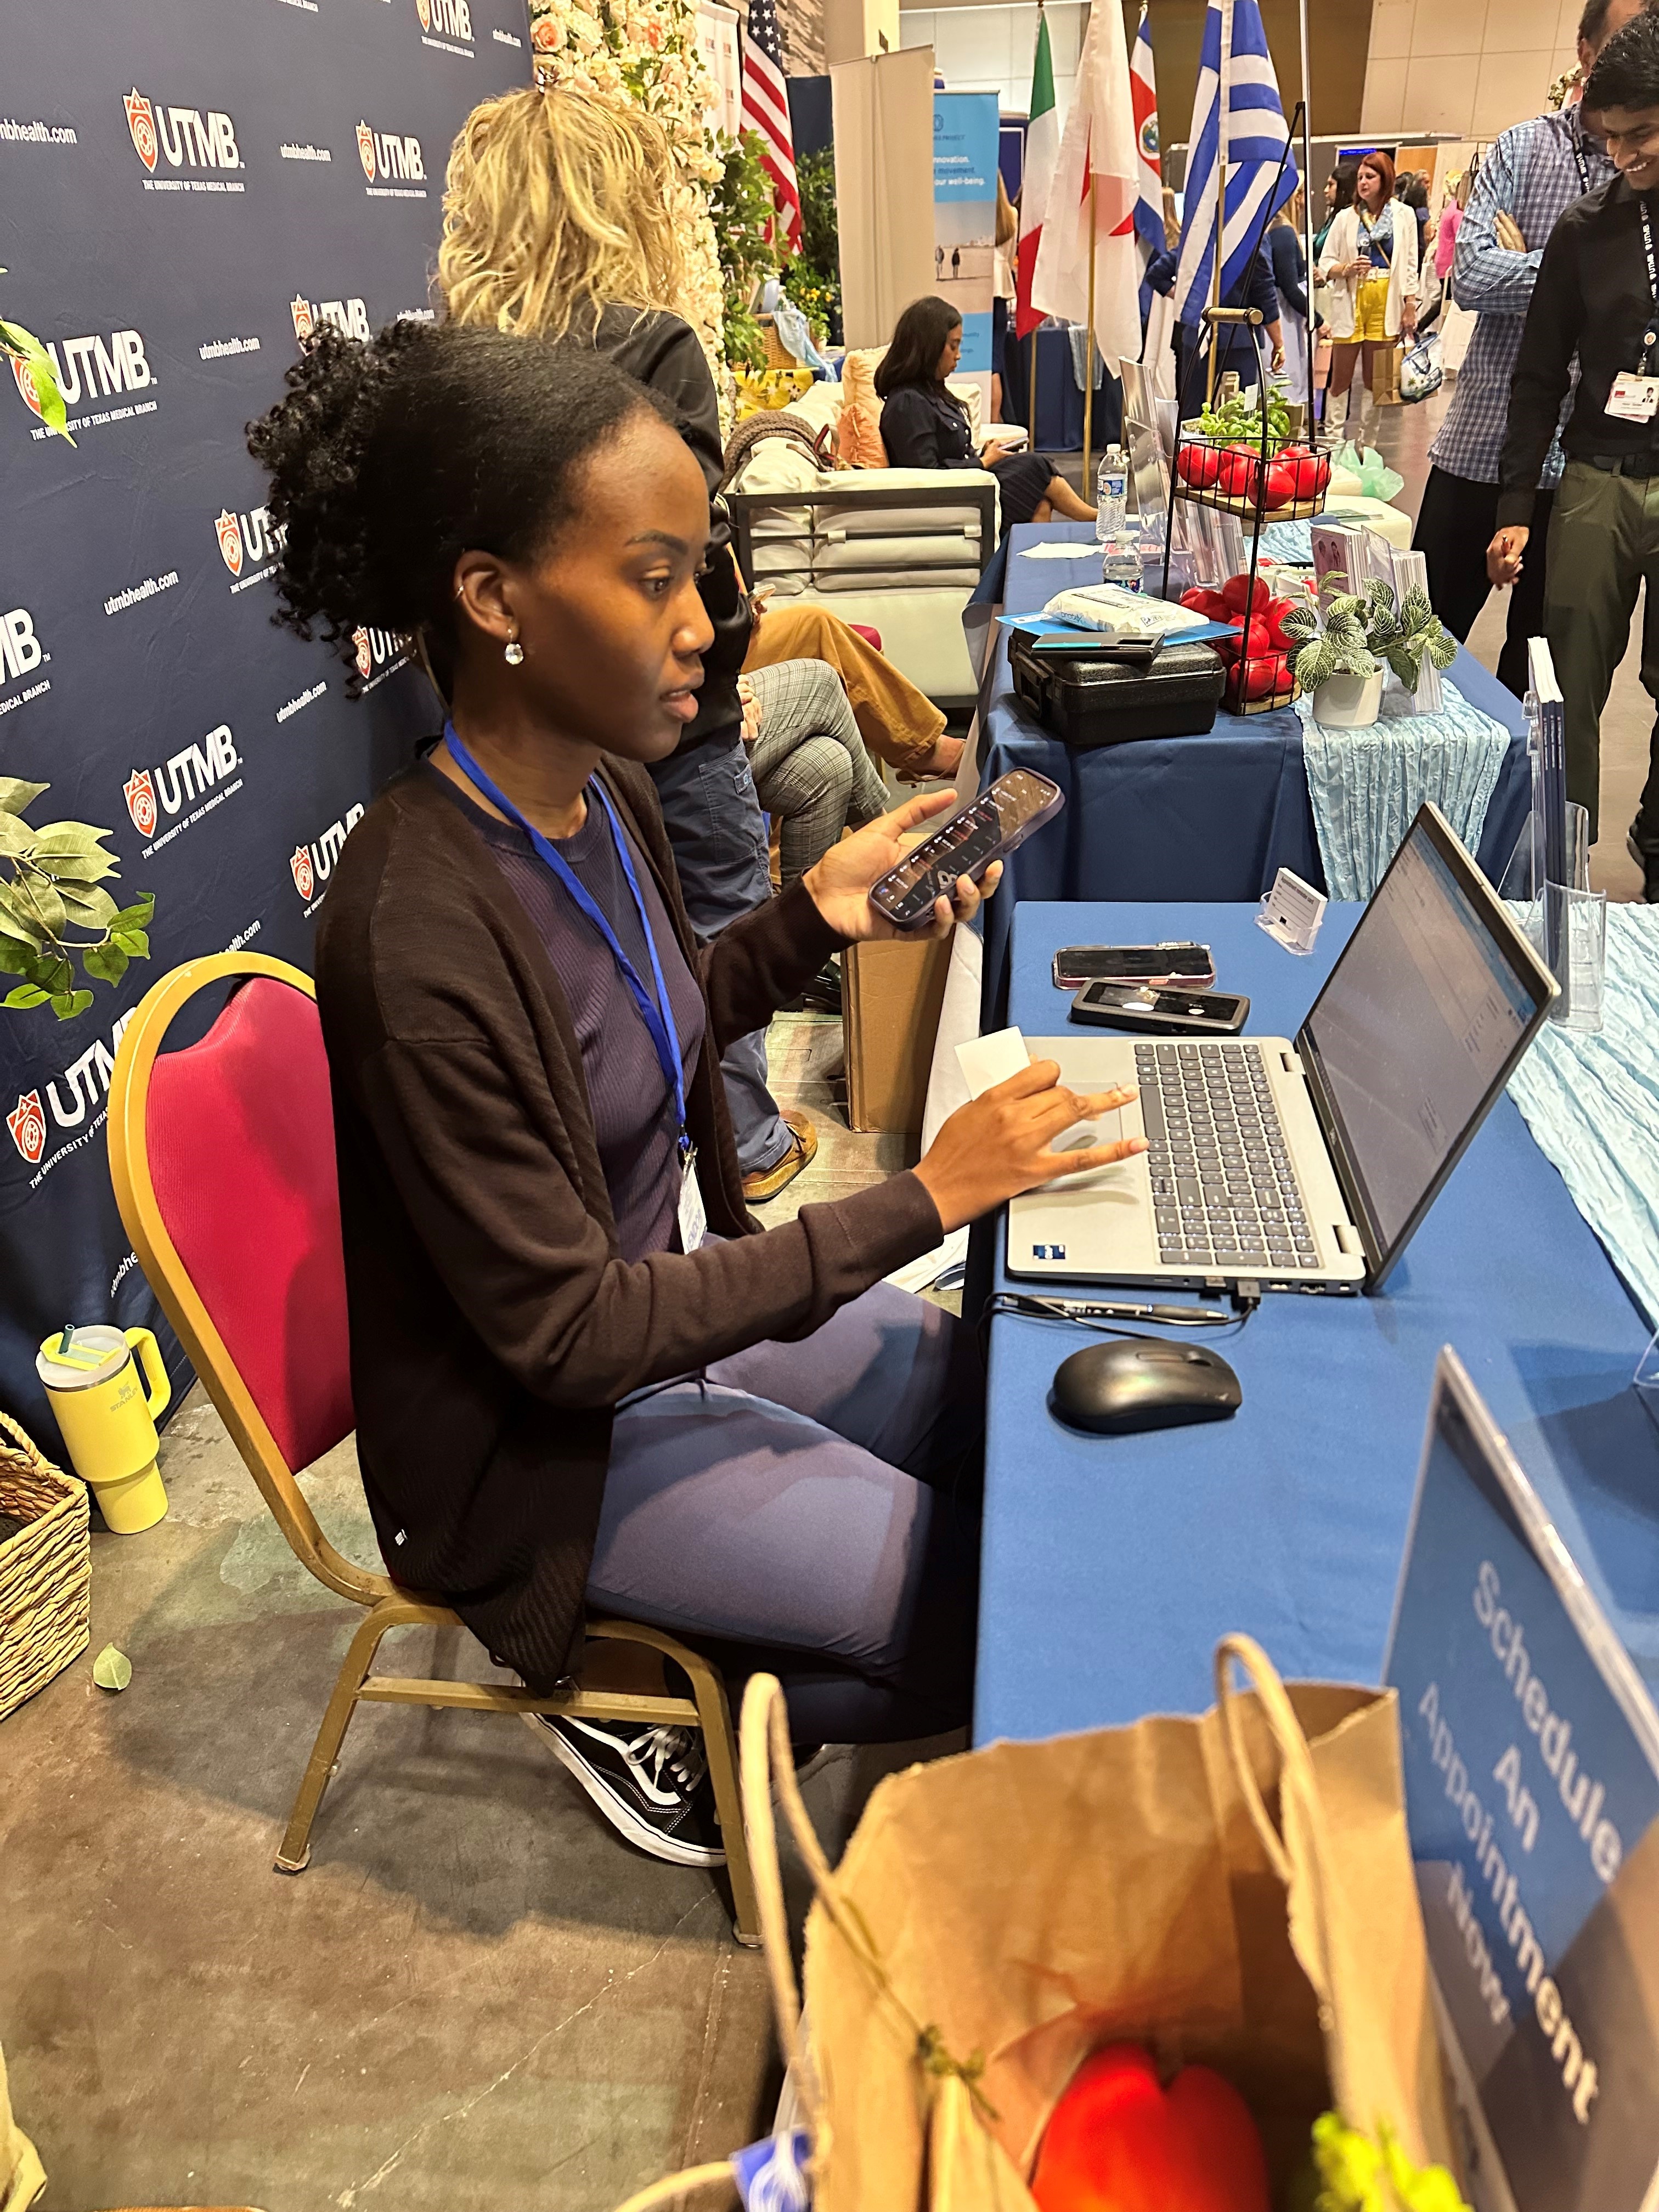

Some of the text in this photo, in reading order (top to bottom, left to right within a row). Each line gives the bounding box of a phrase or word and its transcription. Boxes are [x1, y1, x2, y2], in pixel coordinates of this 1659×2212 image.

[155, 105, 239, 168] UTMB
[374, 133, 424, 179] UTMB
[47, 330, 151, 404] UTMB
[199, 337, 261, 360] utmbhealth.com
[30, 427, 46, 441] THE
[82, 417, 91, 428] OF
[90, 412, 111, 426] TEXAS
[104, 571, 179, 615] utmbhealth.com
[22, 680, 51, 702] BRANCH
[154, 724, 238, 814] UTMB
[142, 845, 154, 859] THE
[153, 823, 182, 851] UNIVERSITY
[182, 818, 189, 829] OF
[189, 806, 206, 823] TEXAS
[29, 1171, 43, 1189] THE
[41, 1133, 89, 1175] UNIVERSITY
[110, 1385, 138, 1412] STANLEY
[1473, 1560, 1623, 1884] Schedule
[1493, 1746, 1541, 1853] An
[1418, 1682, 1599, 2125] Appointment
[1448, 1861, 1510, 2025] Now
